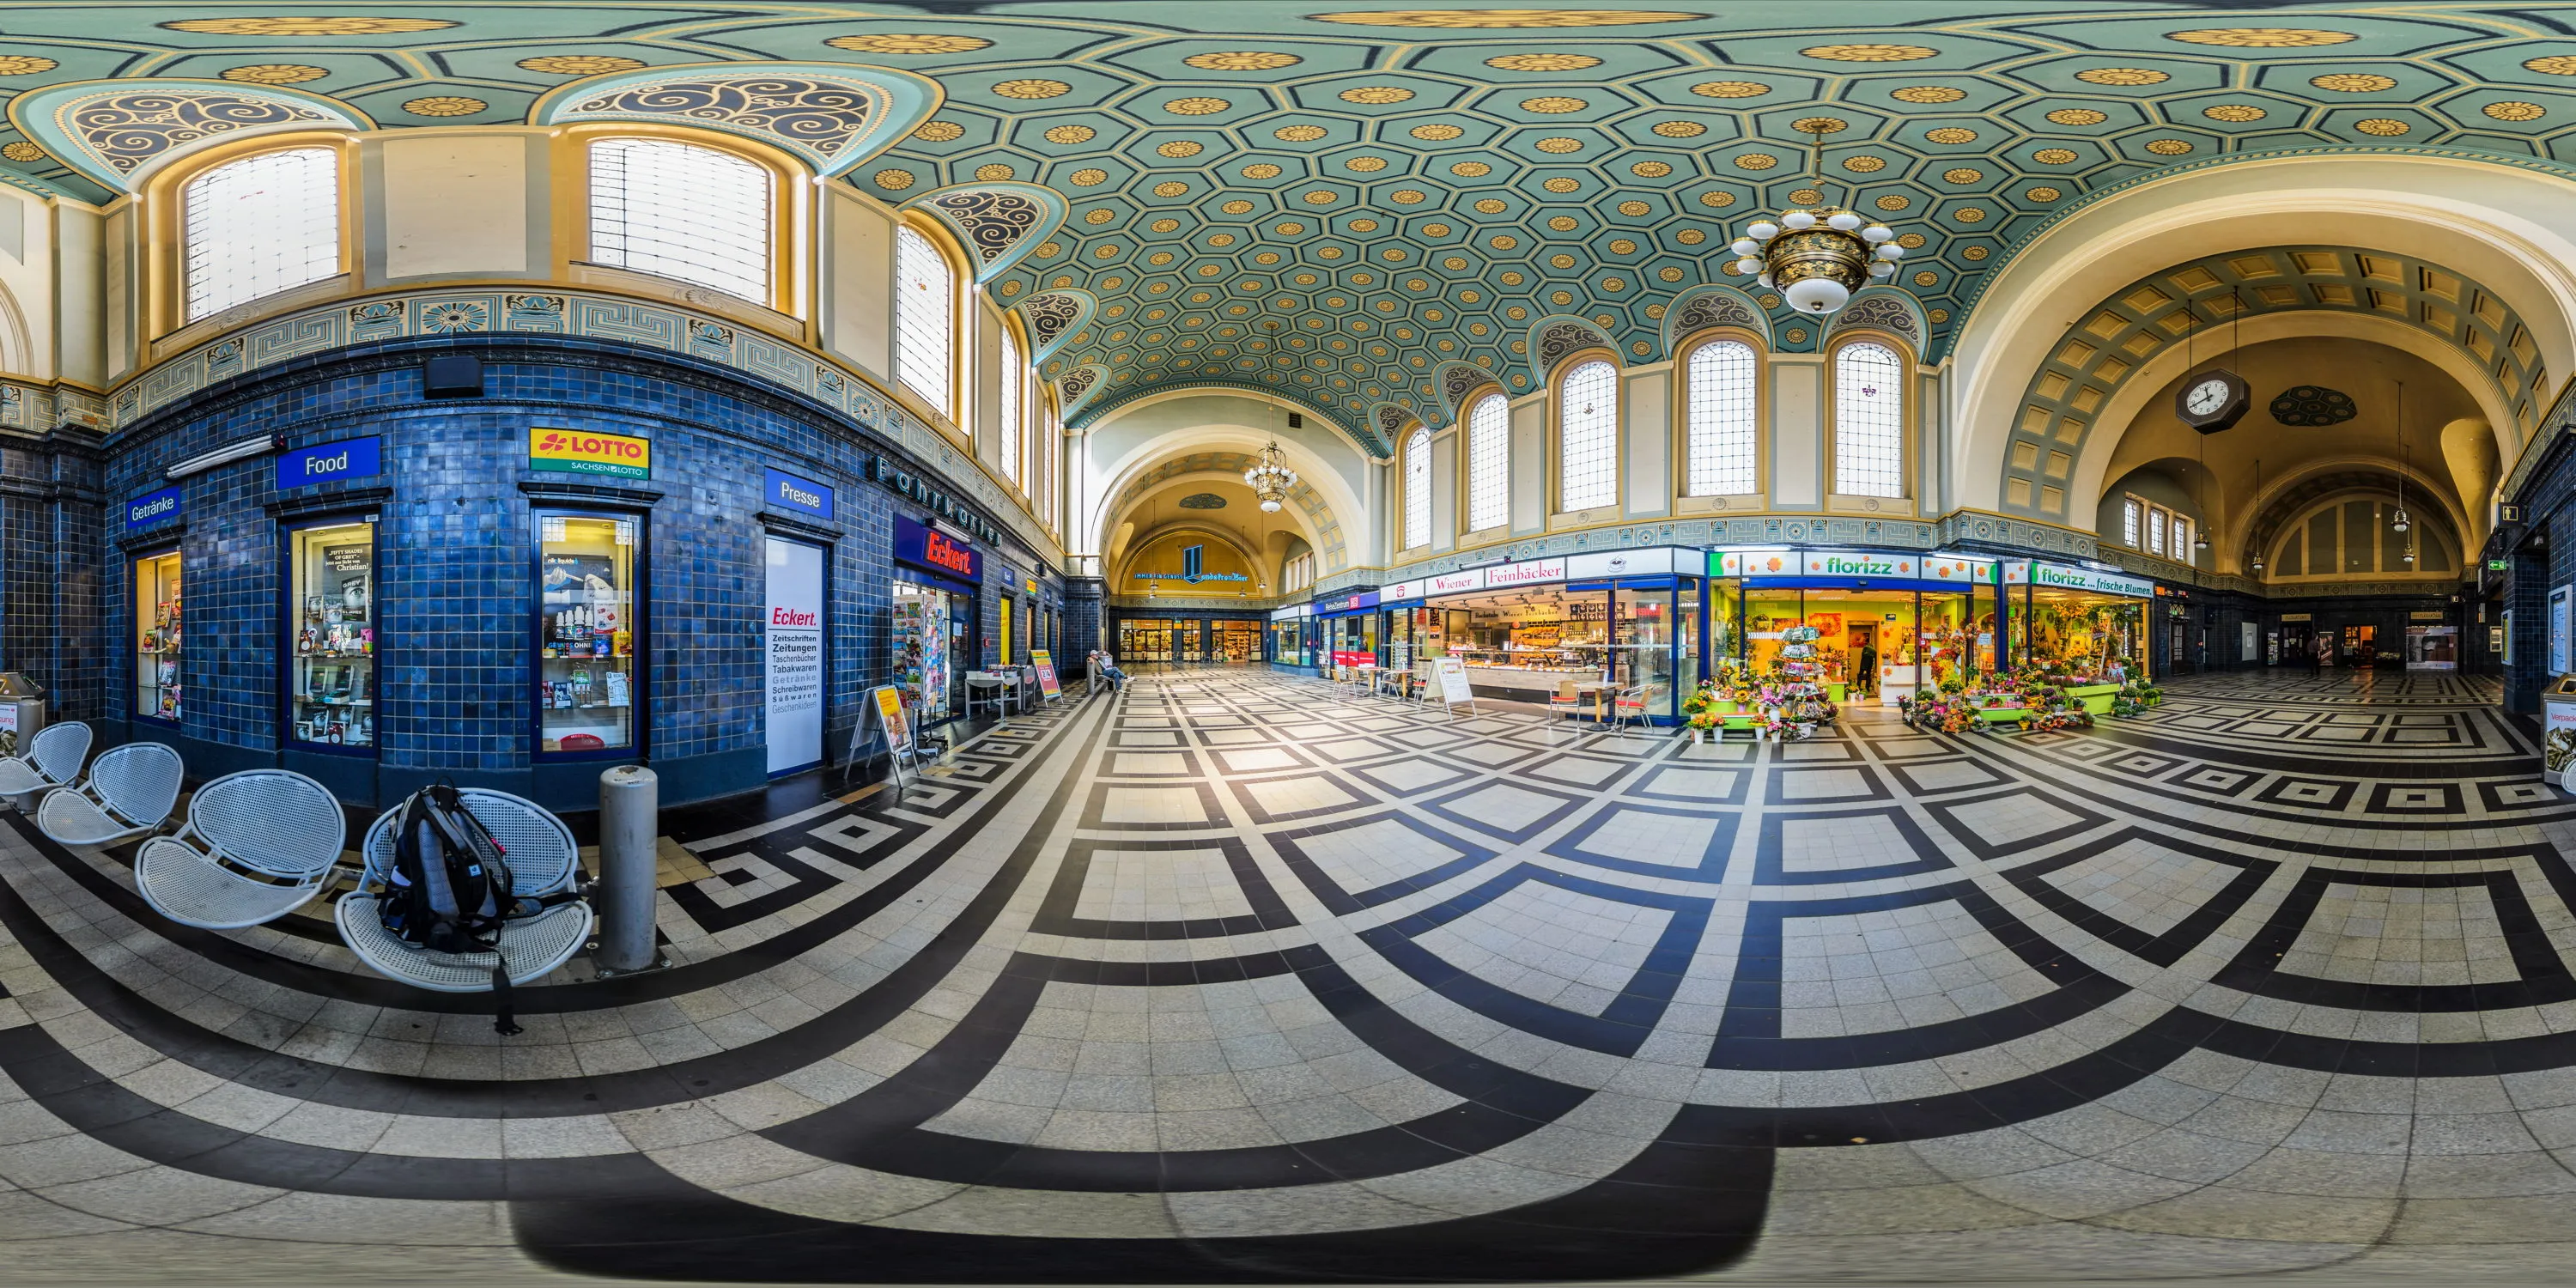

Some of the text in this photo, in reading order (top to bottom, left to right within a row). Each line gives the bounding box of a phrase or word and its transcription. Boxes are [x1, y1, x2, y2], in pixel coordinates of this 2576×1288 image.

[572, 436, 642, 459] LOTTO
[306, 452, 348, 475] Food
[571, 462, 642, 476] SACHSEN LOTTO
[781, 482, 820, 507] Presse
[876, 455, 1003, 548] Fahrkarten
[131, 496, 174, 521] Getränke
[927, 531, 971, 574] Eckert.
[337, 562, 369, 572] Christian!
[1826, 555, 1893, 574] florizz
[1489, 561, 1561, 584] Feinbäcker
[343, 580, 361, 588] GREY
[1436, 576, 1473, 590] Wiener
[2041, 568, 2086, 587] florizz
[2124, 585, 2153, 596] Blumen.
[772, 606, 817, 626] Eckert.
[772, 643, 817, 653] Zeitungen
[772, 654, 817, 663] Taschenbücher
[772, 665, 817, 674] Tabakwaren
[772, 674, 817, 684] Getränke
[772, 683, 817, 694] Schreibwaren
[772, 692, 817, 702] Süßwaren
[772, 701, 817, 714] Geschenkideen
